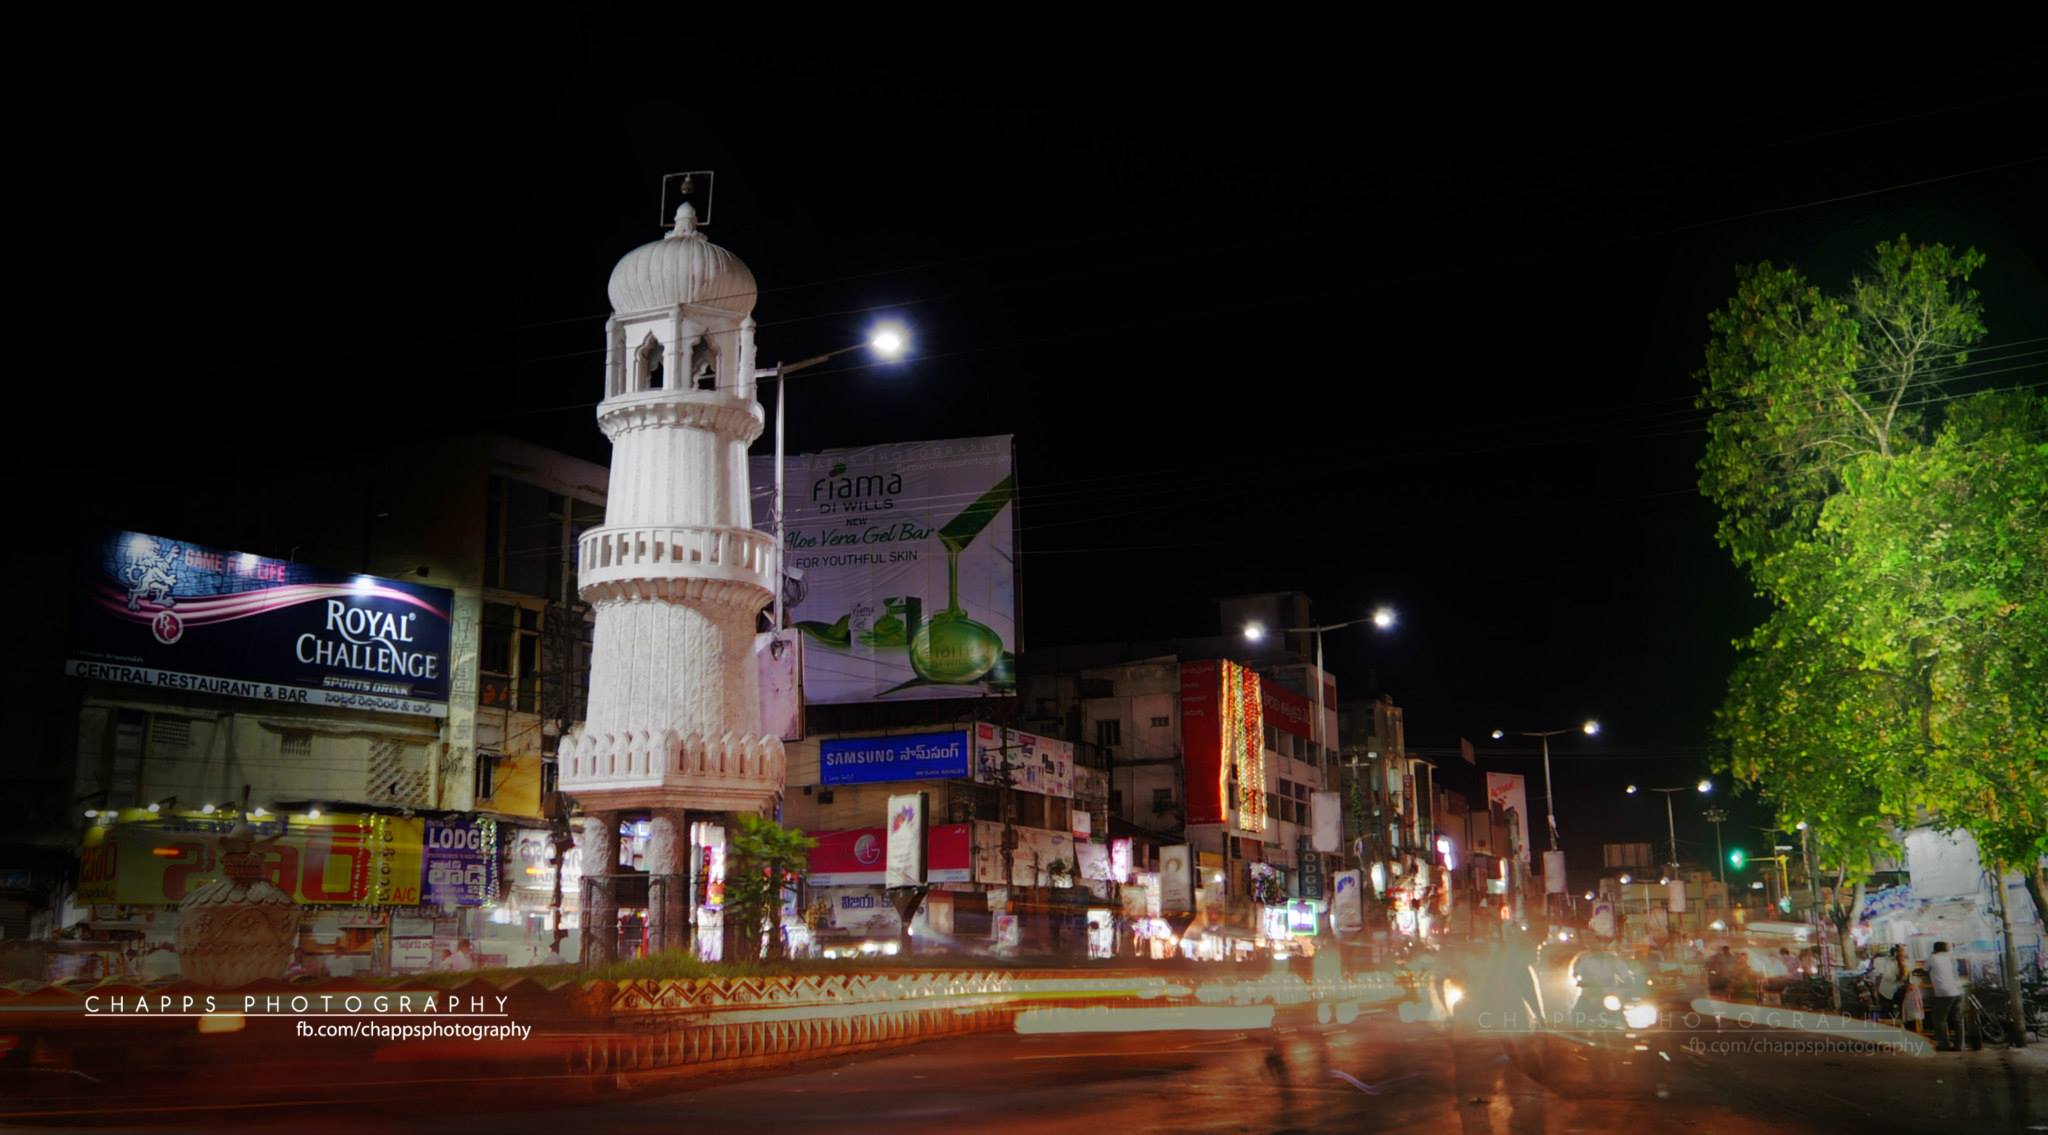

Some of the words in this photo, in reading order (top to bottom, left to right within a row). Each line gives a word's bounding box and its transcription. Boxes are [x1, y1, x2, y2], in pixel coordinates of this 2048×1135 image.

[819, 503, 837, 514] DI
[843, 499, 895, 512] WILLS
[846, 517, 869, 526] NEW
[822, 528, 860, 546] Vera
[863, 526, 896, 544] Gel
[900, 523, 935, 542] Bar
[184, 549, 222, 571] GAME
[258, 563, 286, 582] LIFE
[796, 557, 821, 569] FOR
[823, 552, 886, 567] YOUTHFUL
[890, 550, 918, 563] SKIN
[296, 633, 439, 680] CHALLENGE
[76, 662, 153, 684] CENTRAL
[157, 672, 260, 698] RESTAURANT
[264, 685, 273, 698] &
[278, 687, 308, 703] BAR
[322, 676, 370, 691] SPORTS
[826, 748, 895, 766] SAMSUNG
[392, 887, 416, 902] A/C
